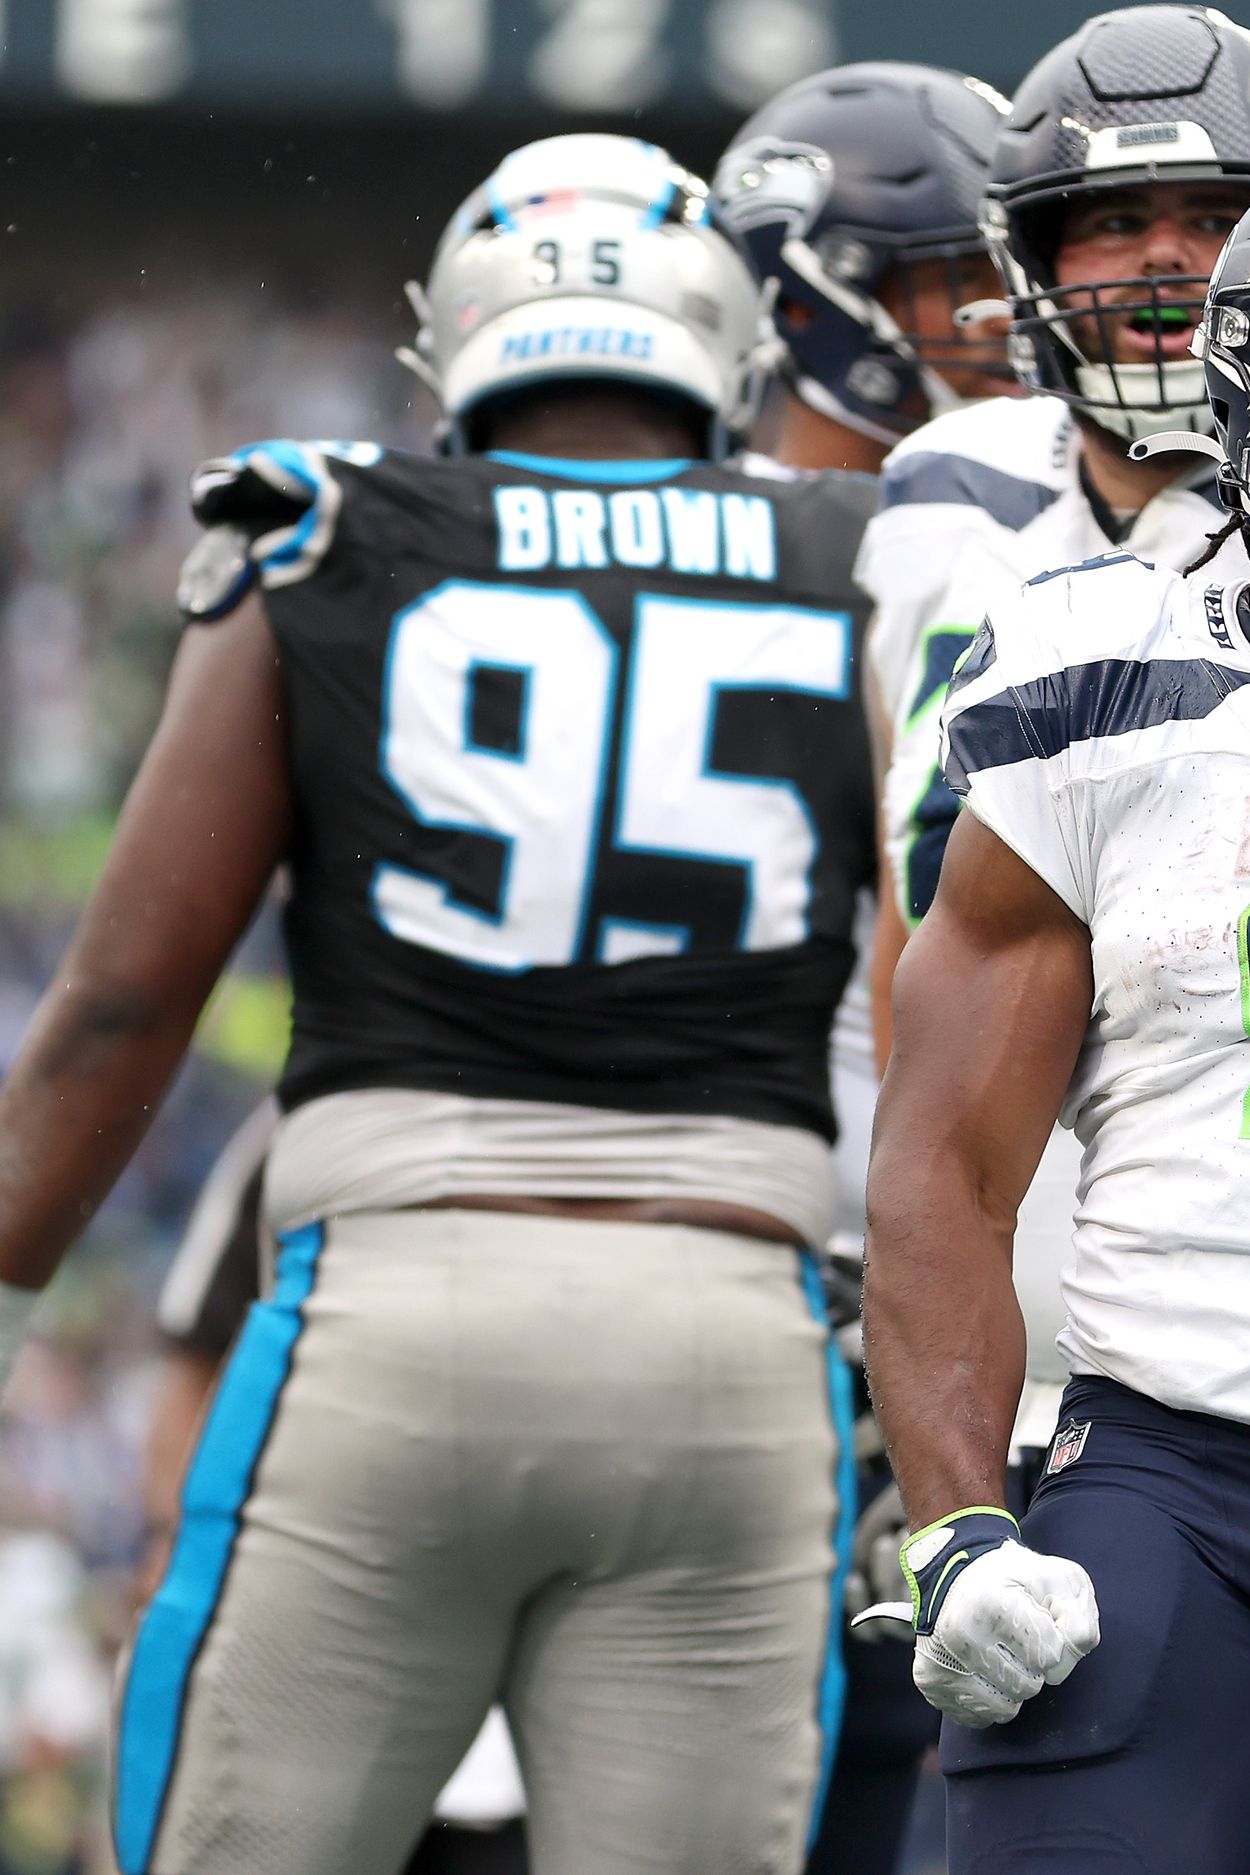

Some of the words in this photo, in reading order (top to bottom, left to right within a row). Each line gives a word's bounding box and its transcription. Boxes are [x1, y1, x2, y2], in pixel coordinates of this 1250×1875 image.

[501, 326, 655, 362] PANTHERS
[493, 486, 779, 581] BROWN
[368, 578, 853, 976] 95
